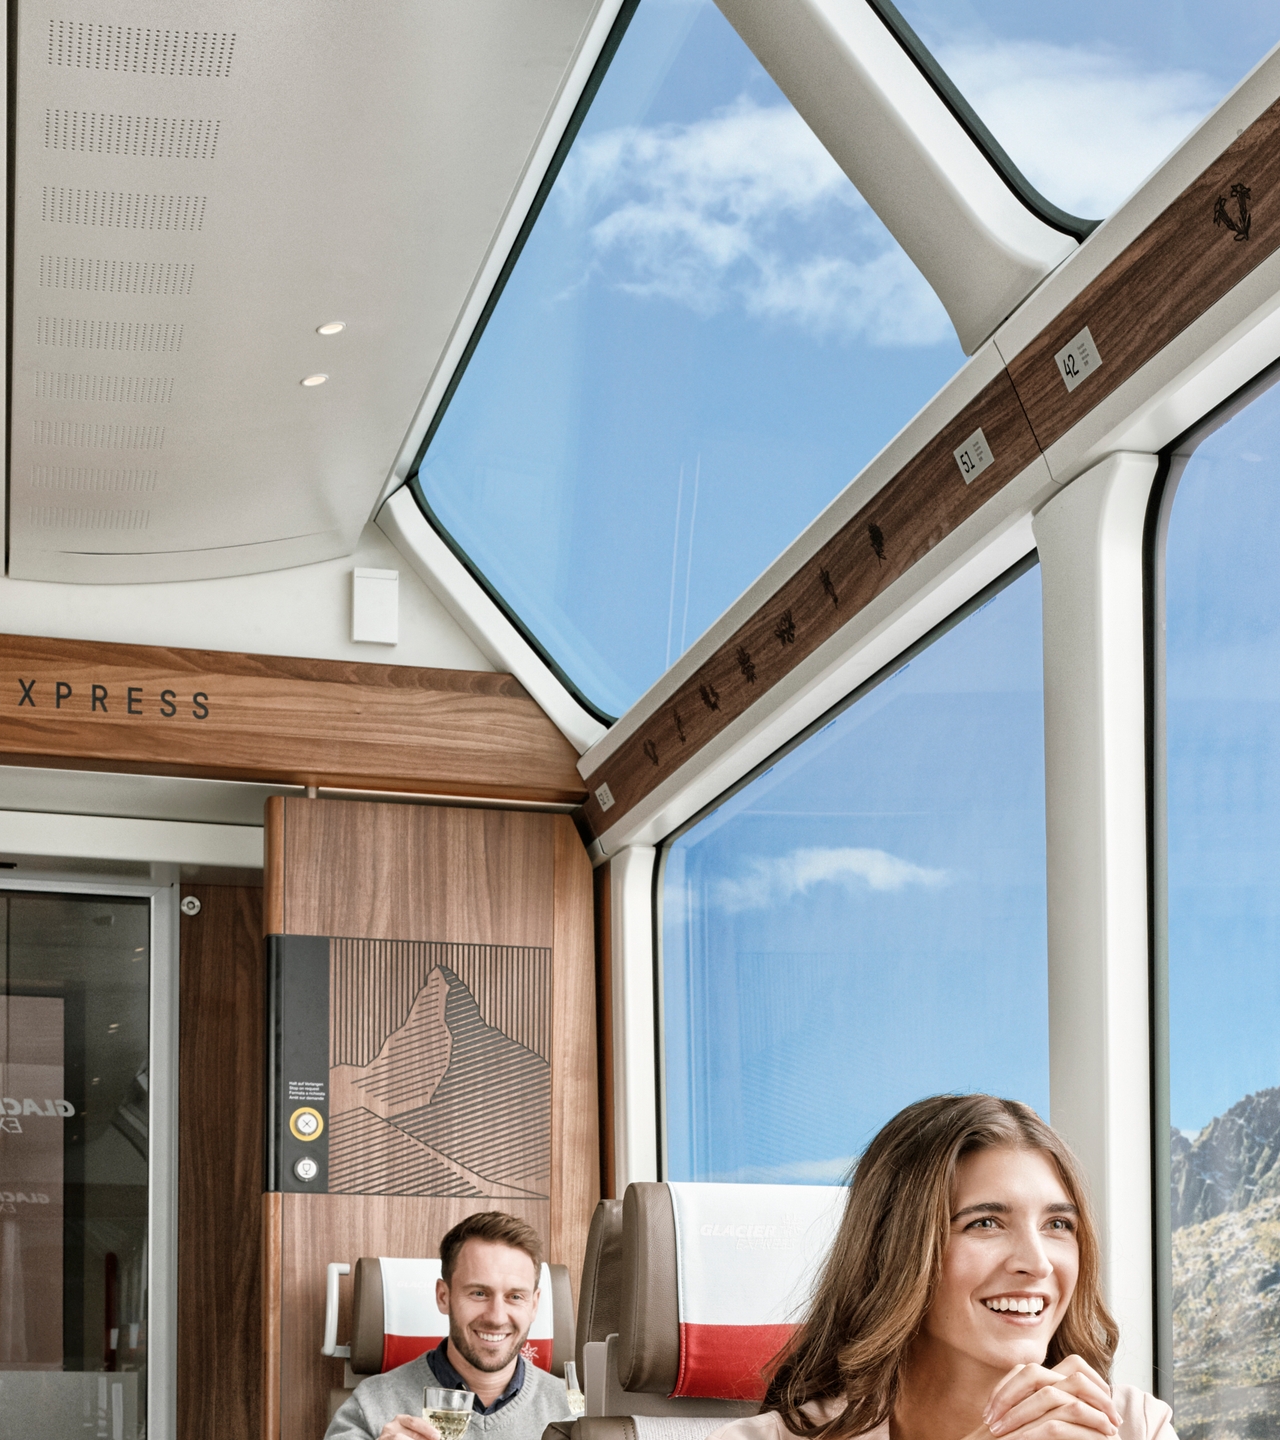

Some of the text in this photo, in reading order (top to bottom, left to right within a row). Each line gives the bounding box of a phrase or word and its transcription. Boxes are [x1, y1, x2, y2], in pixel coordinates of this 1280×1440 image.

[1063, 354, 1080, 378] 42
[959, 451, 976, 474] 51
[699, 1223, 777, 1238] GLACIER
